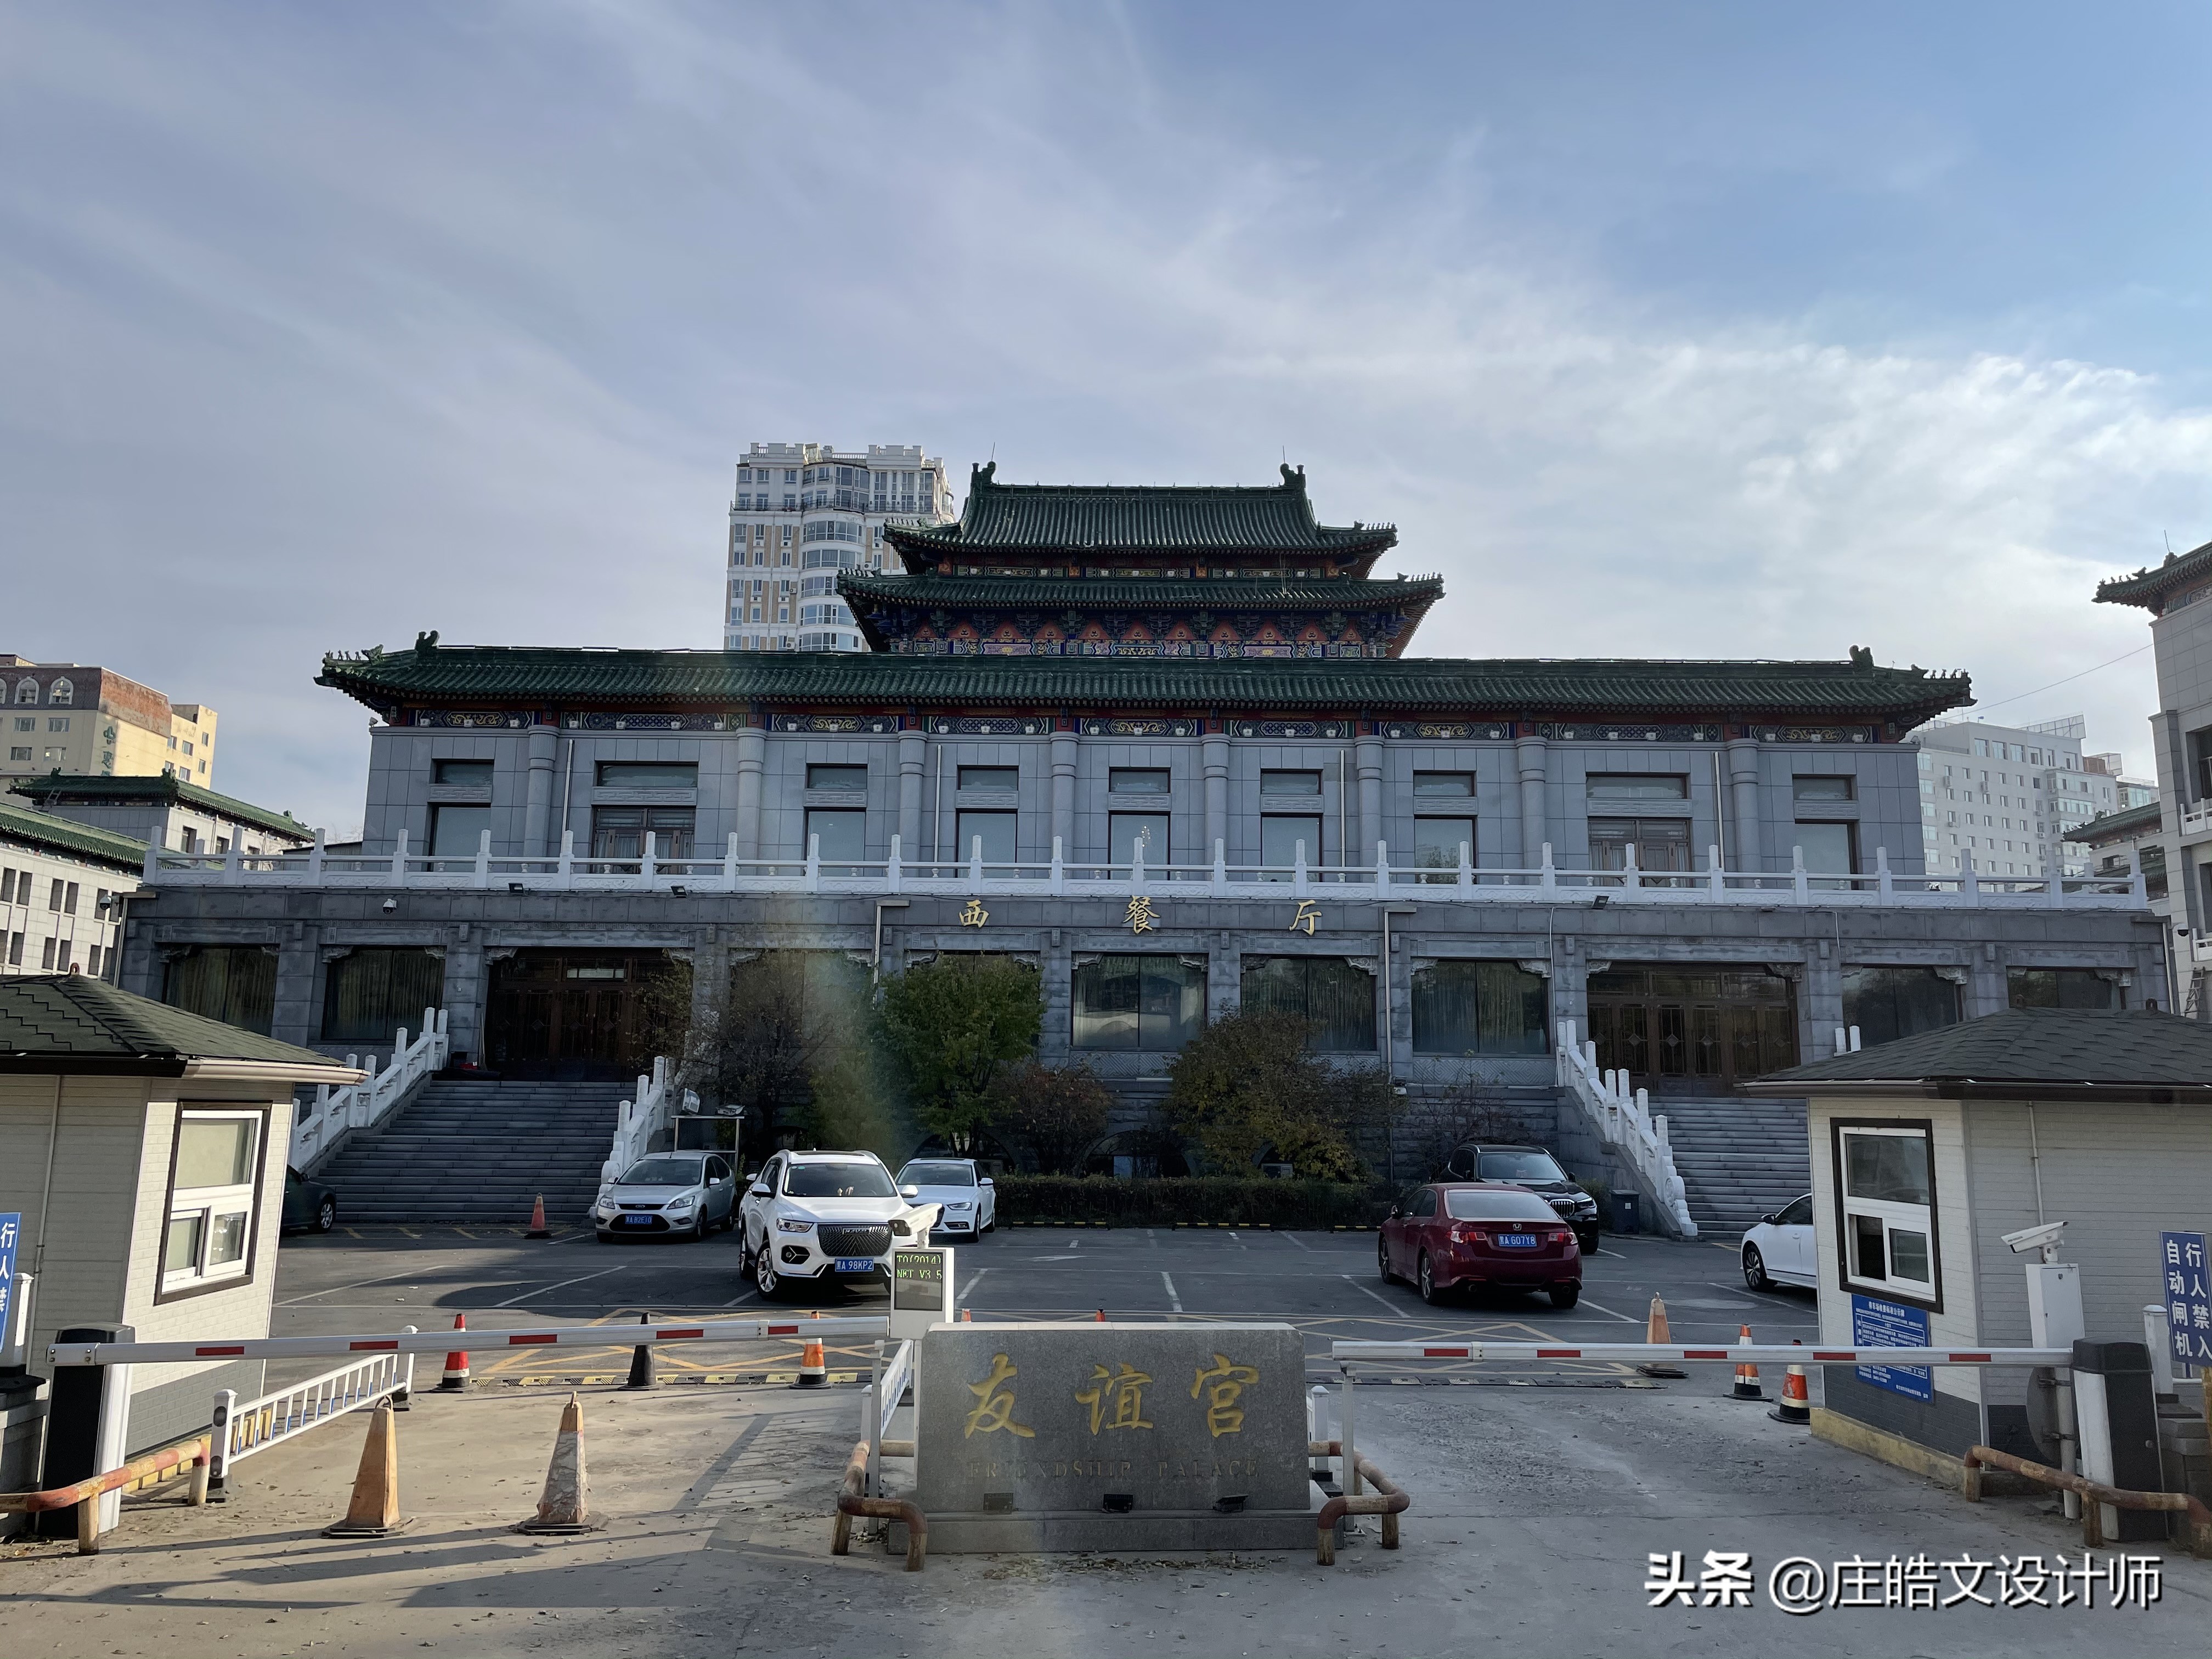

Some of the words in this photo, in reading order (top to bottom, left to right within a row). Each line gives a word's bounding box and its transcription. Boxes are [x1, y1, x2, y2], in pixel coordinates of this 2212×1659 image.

[958, 895, 1322, 936] 西餐厅
[2166, 1239, 2193, 1357] 自动闸机
[2185, 1242, 2212, 1360] 行人禁入
[964, 1352, 1260, 1438] 友谊宫
[969, 1459, 1132, 1478] FRNDSHIP
